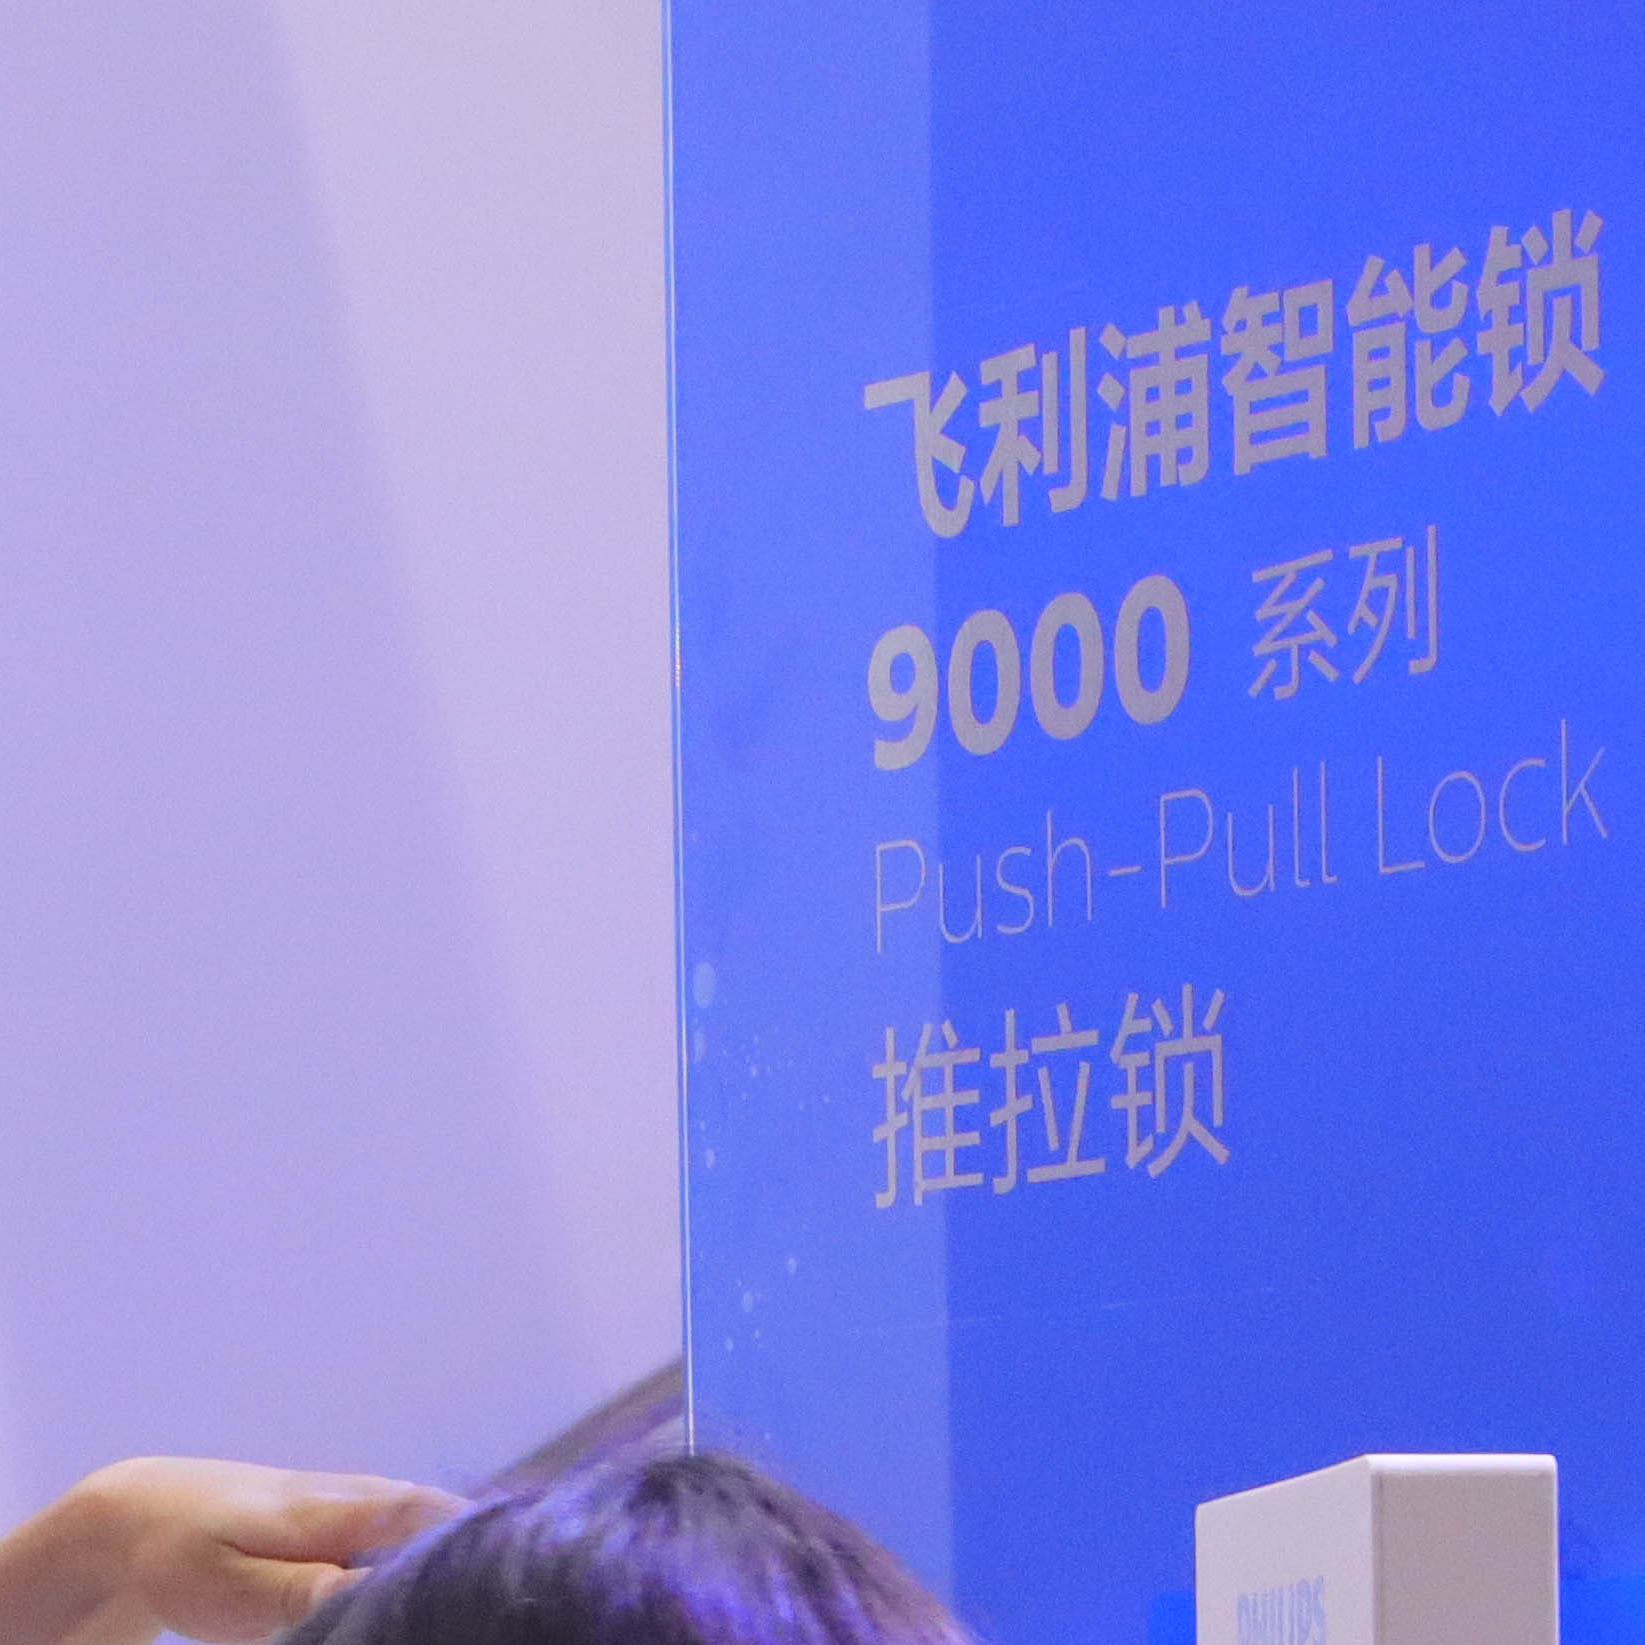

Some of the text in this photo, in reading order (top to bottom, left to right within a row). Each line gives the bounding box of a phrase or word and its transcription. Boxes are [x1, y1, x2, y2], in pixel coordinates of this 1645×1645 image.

[864, 208, 1605, 539] 飞利浦智能锁
[867, 525, 1438, 771] 9000 系列
[876, 718, 1608, 953] Push-Pull Lock
[872, 983, 1231, 1209] 推拉锁
